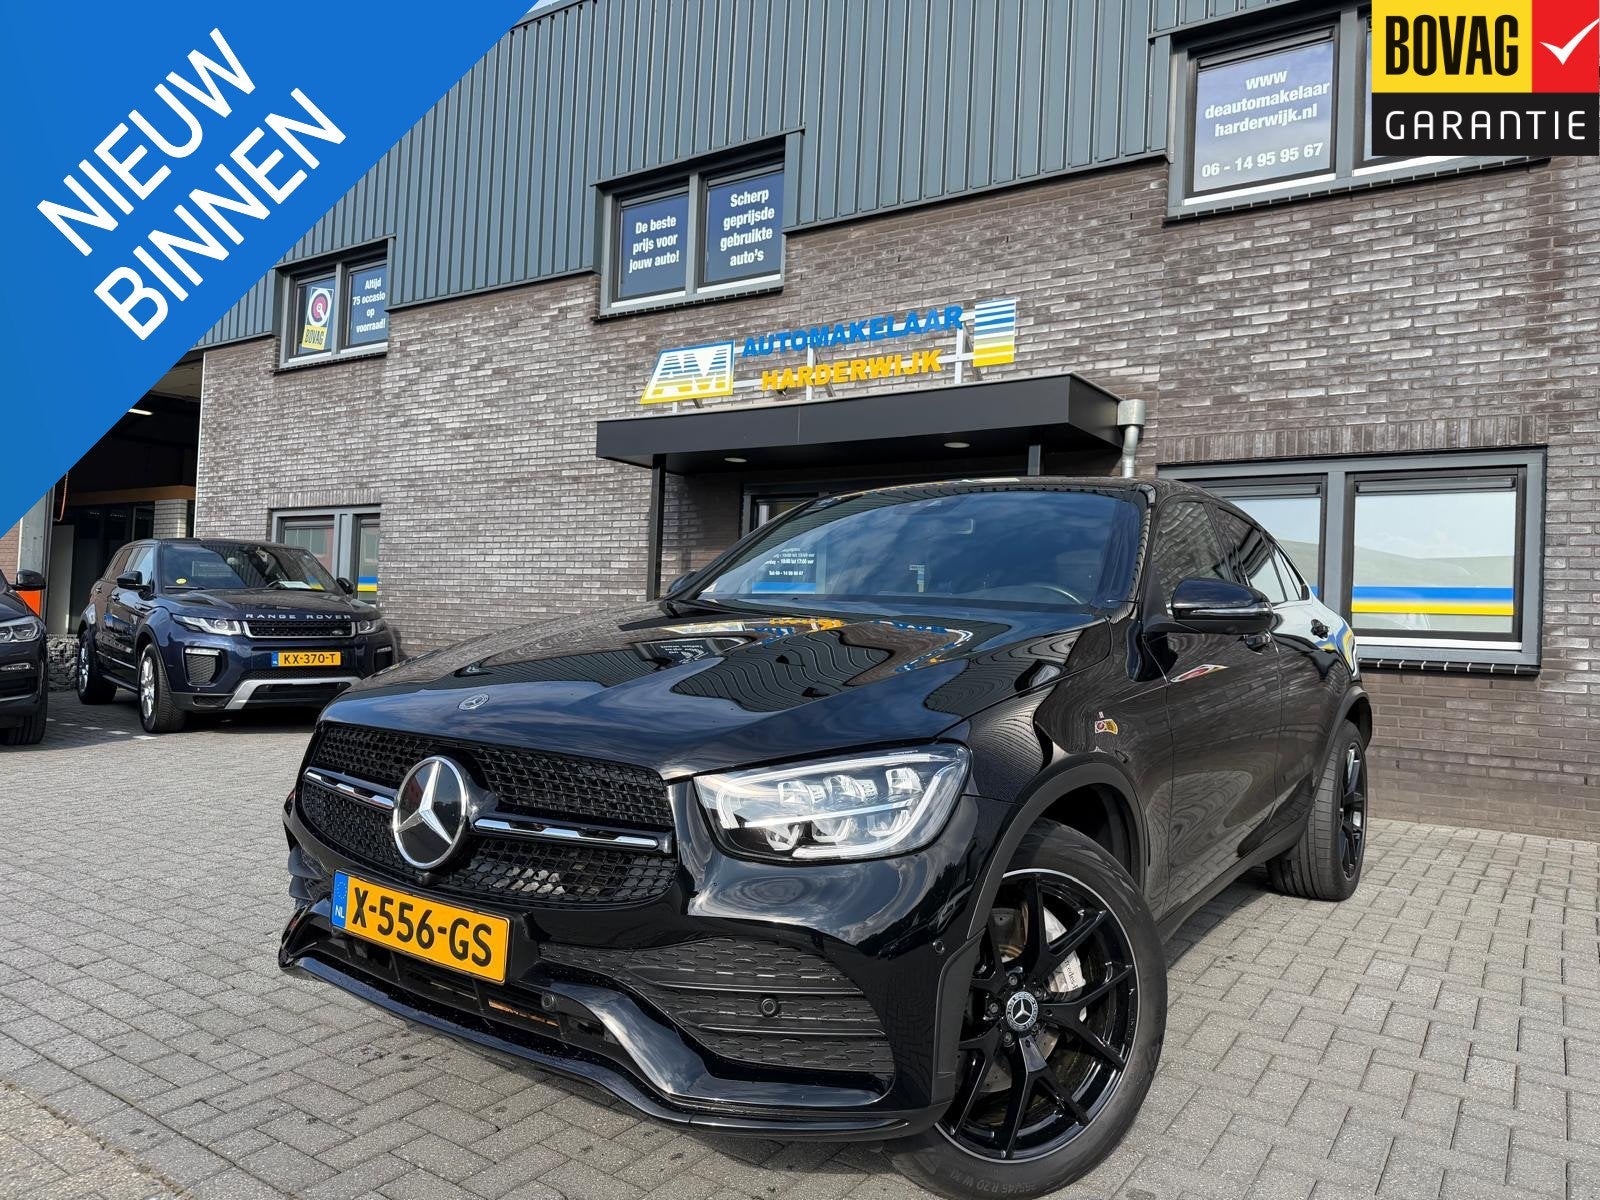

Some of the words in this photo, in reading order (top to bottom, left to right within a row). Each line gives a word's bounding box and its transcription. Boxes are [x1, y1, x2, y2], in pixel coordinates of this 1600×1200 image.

[1245, 70, 1288, 90] www
[1204, 82, 1331, 119] deautomakelaar
[1214, 103, 1318, 137] harderwijk.nl
[1202, 163, 1219, 177] 06
[1234, 156, 1253, 172] 14
[1256, 151, 1276, 168] 95
[1279, 147, 1300, 163] 95
[1303, 142, 1324, 158] 67
[730, 188, 770, 208] Scherp
[635, 221, 648, 235] De
[650, 215, 677, 232] beste
[723, 206, 775, 231] geprijsde
[632, 238, 654, 256] prijs
[656, 234, 678, 249] voor
[720, 226, 773, 252] gebruikte
[629, 258, 652, 274] jouw
[654, 250, 680, 267] auto!
[729, 248, 764, 267] auto's
[365, 278, 381, 289] Altijd
[352, 295, 361, 306] 75
[366, 308, 375, 319] op
[741, 304, 965, 358] AUTOMAKELAAR
[761, 349, 944, 392] HARDERWIJK
[284, 653, 336, 665] KX-370-T
[334, 904, 345, 919] NL
[351, 886, 493, 968] X-556-GS
